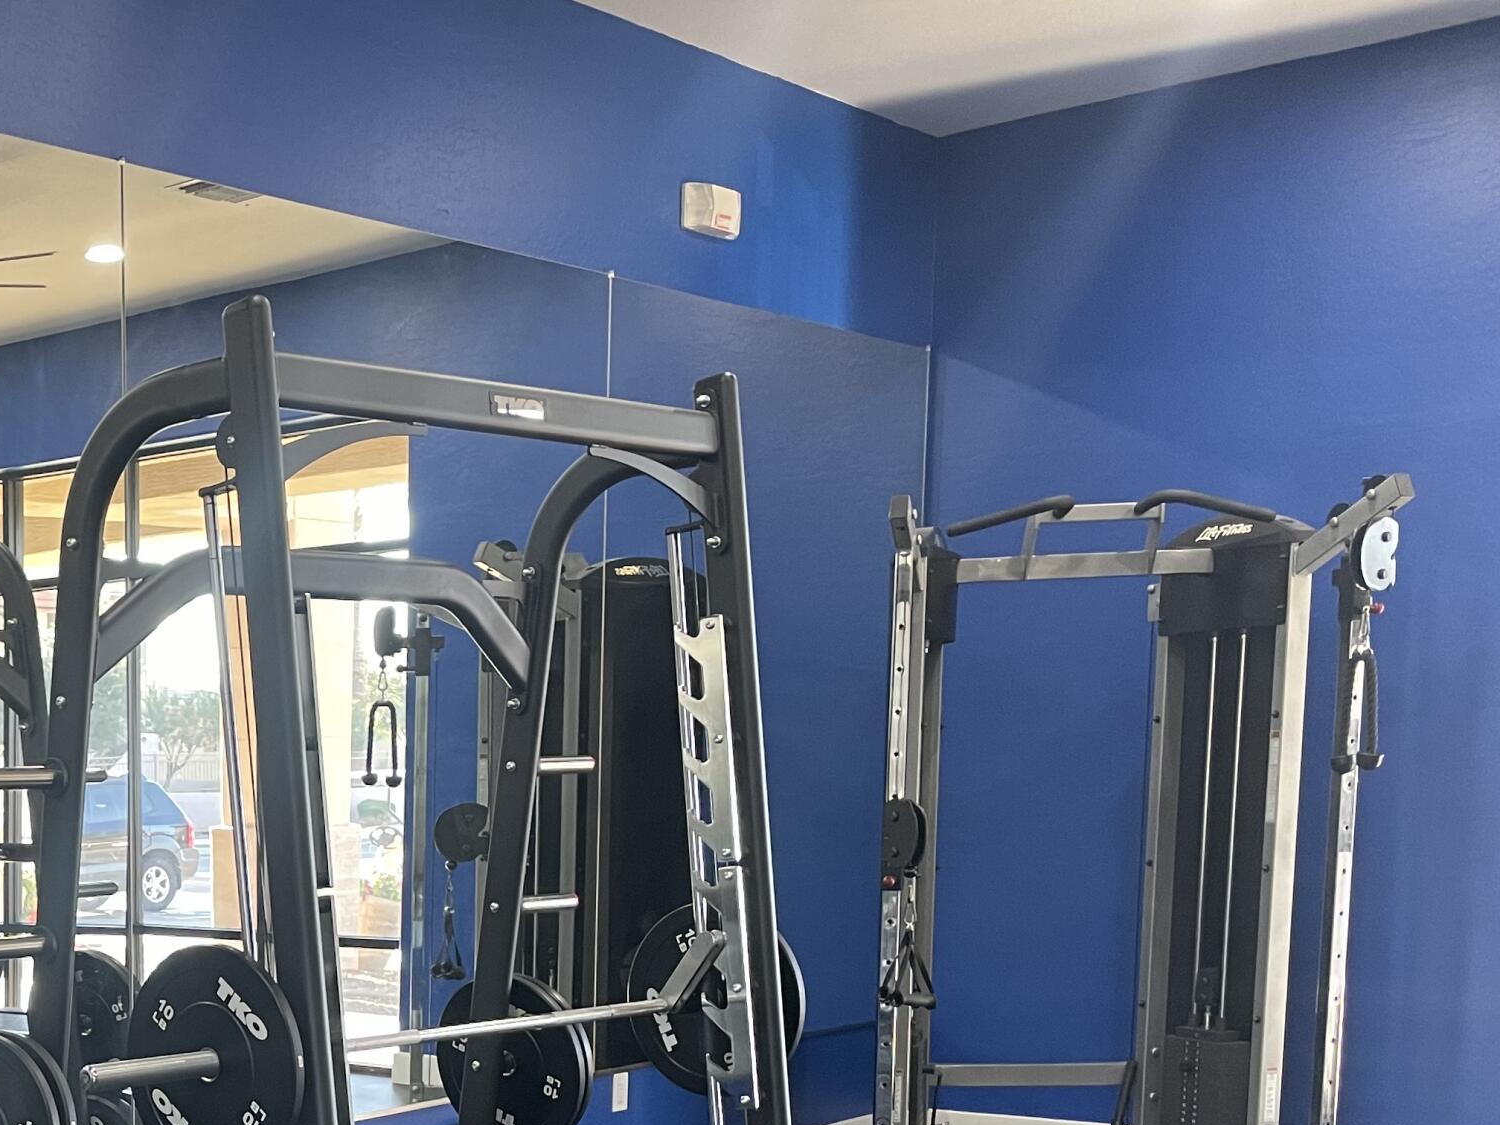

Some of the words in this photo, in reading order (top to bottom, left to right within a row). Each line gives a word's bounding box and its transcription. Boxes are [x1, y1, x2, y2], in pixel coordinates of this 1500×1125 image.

[159, 999, 174, 1021] 10
[216, 976, 268, 1041] TKO
[152, 1011, 167, 1031] LB
[543, 1084, 559, 1100] 10
[546, 1075, 561, 1088] LB
[250, 1100, 267, 1122] LB
